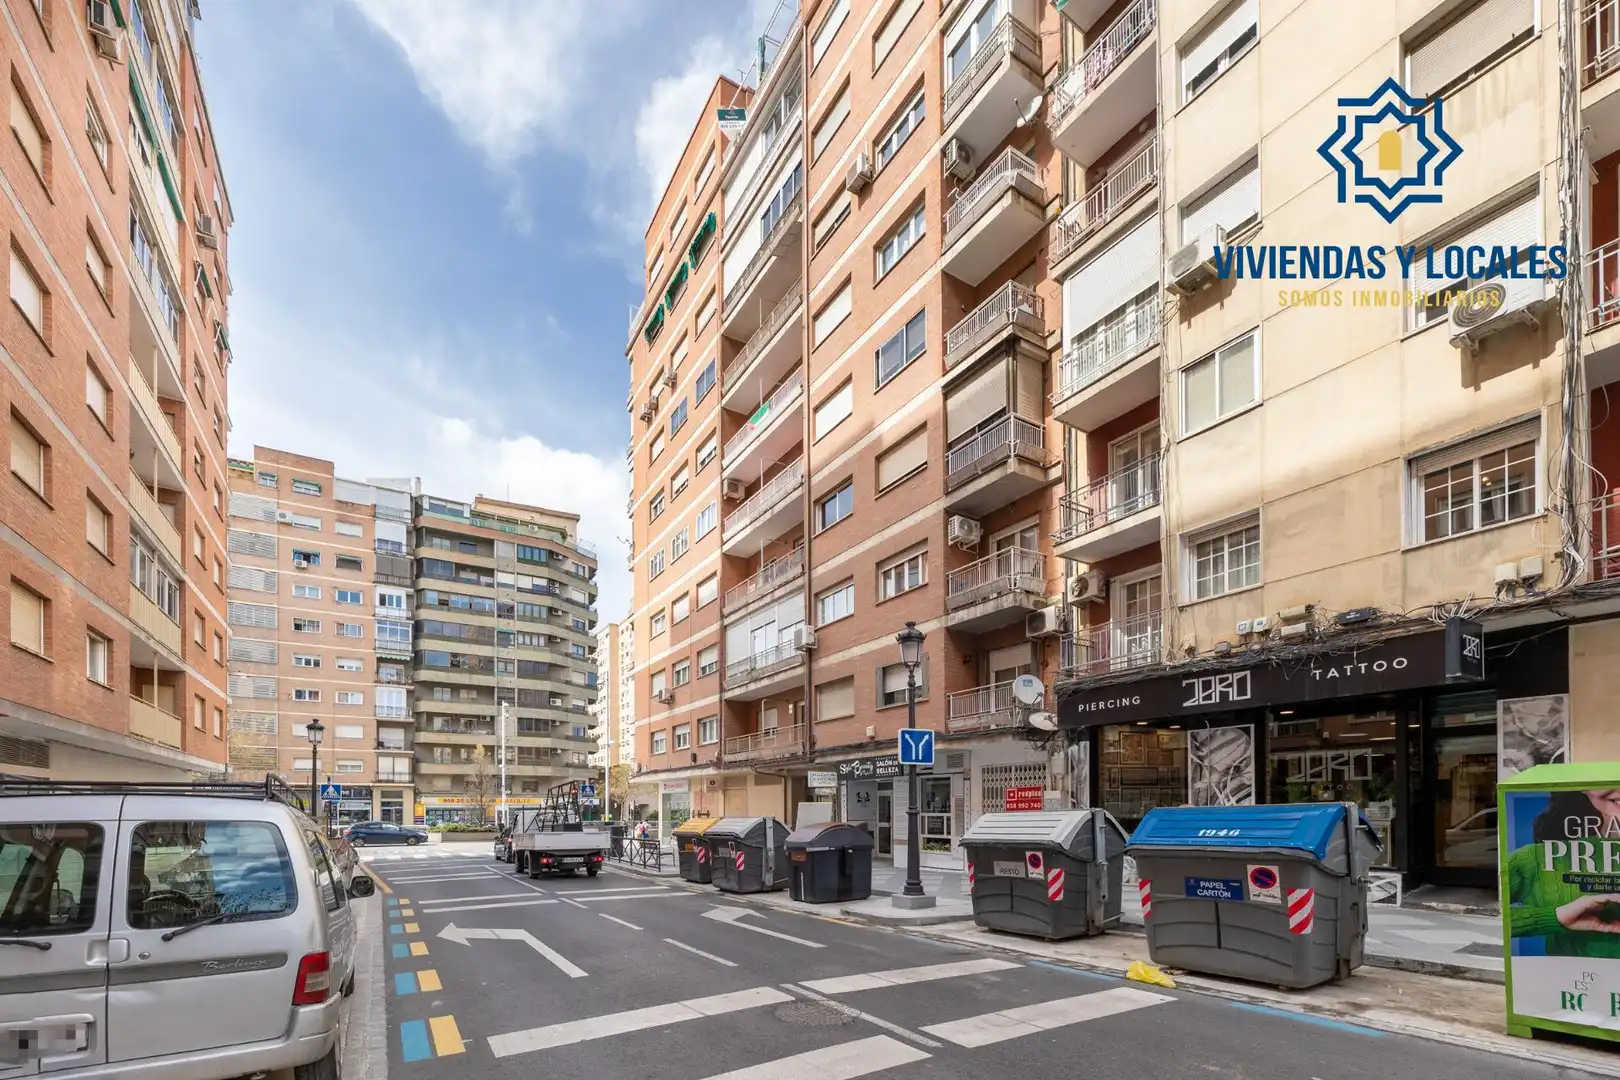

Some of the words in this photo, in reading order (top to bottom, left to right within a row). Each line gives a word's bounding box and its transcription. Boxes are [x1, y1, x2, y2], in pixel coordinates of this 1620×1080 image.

[1313, 657, 1408, 680] TATTOO
[1078, 695, 1140, 712] PIERCING
[876, 759, 893, 767] SALÓN
[1198, 828, 1240, 836] 1946
[1200, 881, 1227, 890] PAPEL
[1197, 888, 1231, 898] CARTÓN
